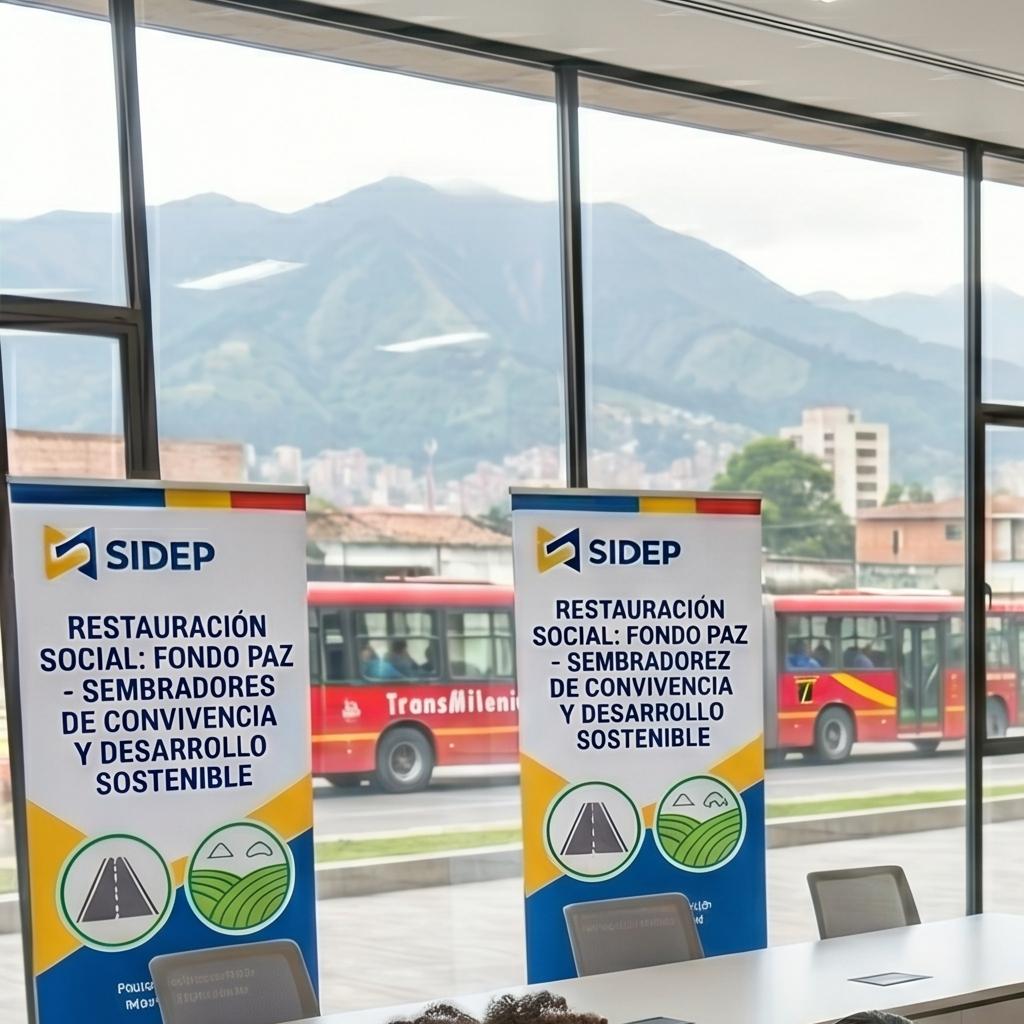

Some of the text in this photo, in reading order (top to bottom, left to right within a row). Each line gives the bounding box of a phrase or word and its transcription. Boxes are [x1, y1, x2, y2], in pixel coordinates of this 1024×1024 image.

[106, 539, 216, 571] SIDEP
[588, 538, 682, 566] SIDEP
[556, 594, 725, 620] RESTAURACIÓN
[68, 609, 267, 640] RESTAURACIÓN
[532, 624, 748, 646] SOCIAL: FONDO PAZ
[40, 644, 294, 672] SOCIAL: FONDO PAZ
[567, 650, 731, 672] SEMBRADOREZ
[82, 674, 276, 702] SEMBRADORES
[550, 676, 733, 698] DE CONVIVENCIA
[62, 704, 278, 735] DE CONVIVENCIA
[559, 701, 724, 724] Y DESARROLLO
[74, 734, 267, 766] Y DESARROLLO
[576, 727, 711, 750] SOSTENIBLE
[96, 764, 253, 795] SOSTENIBLE
